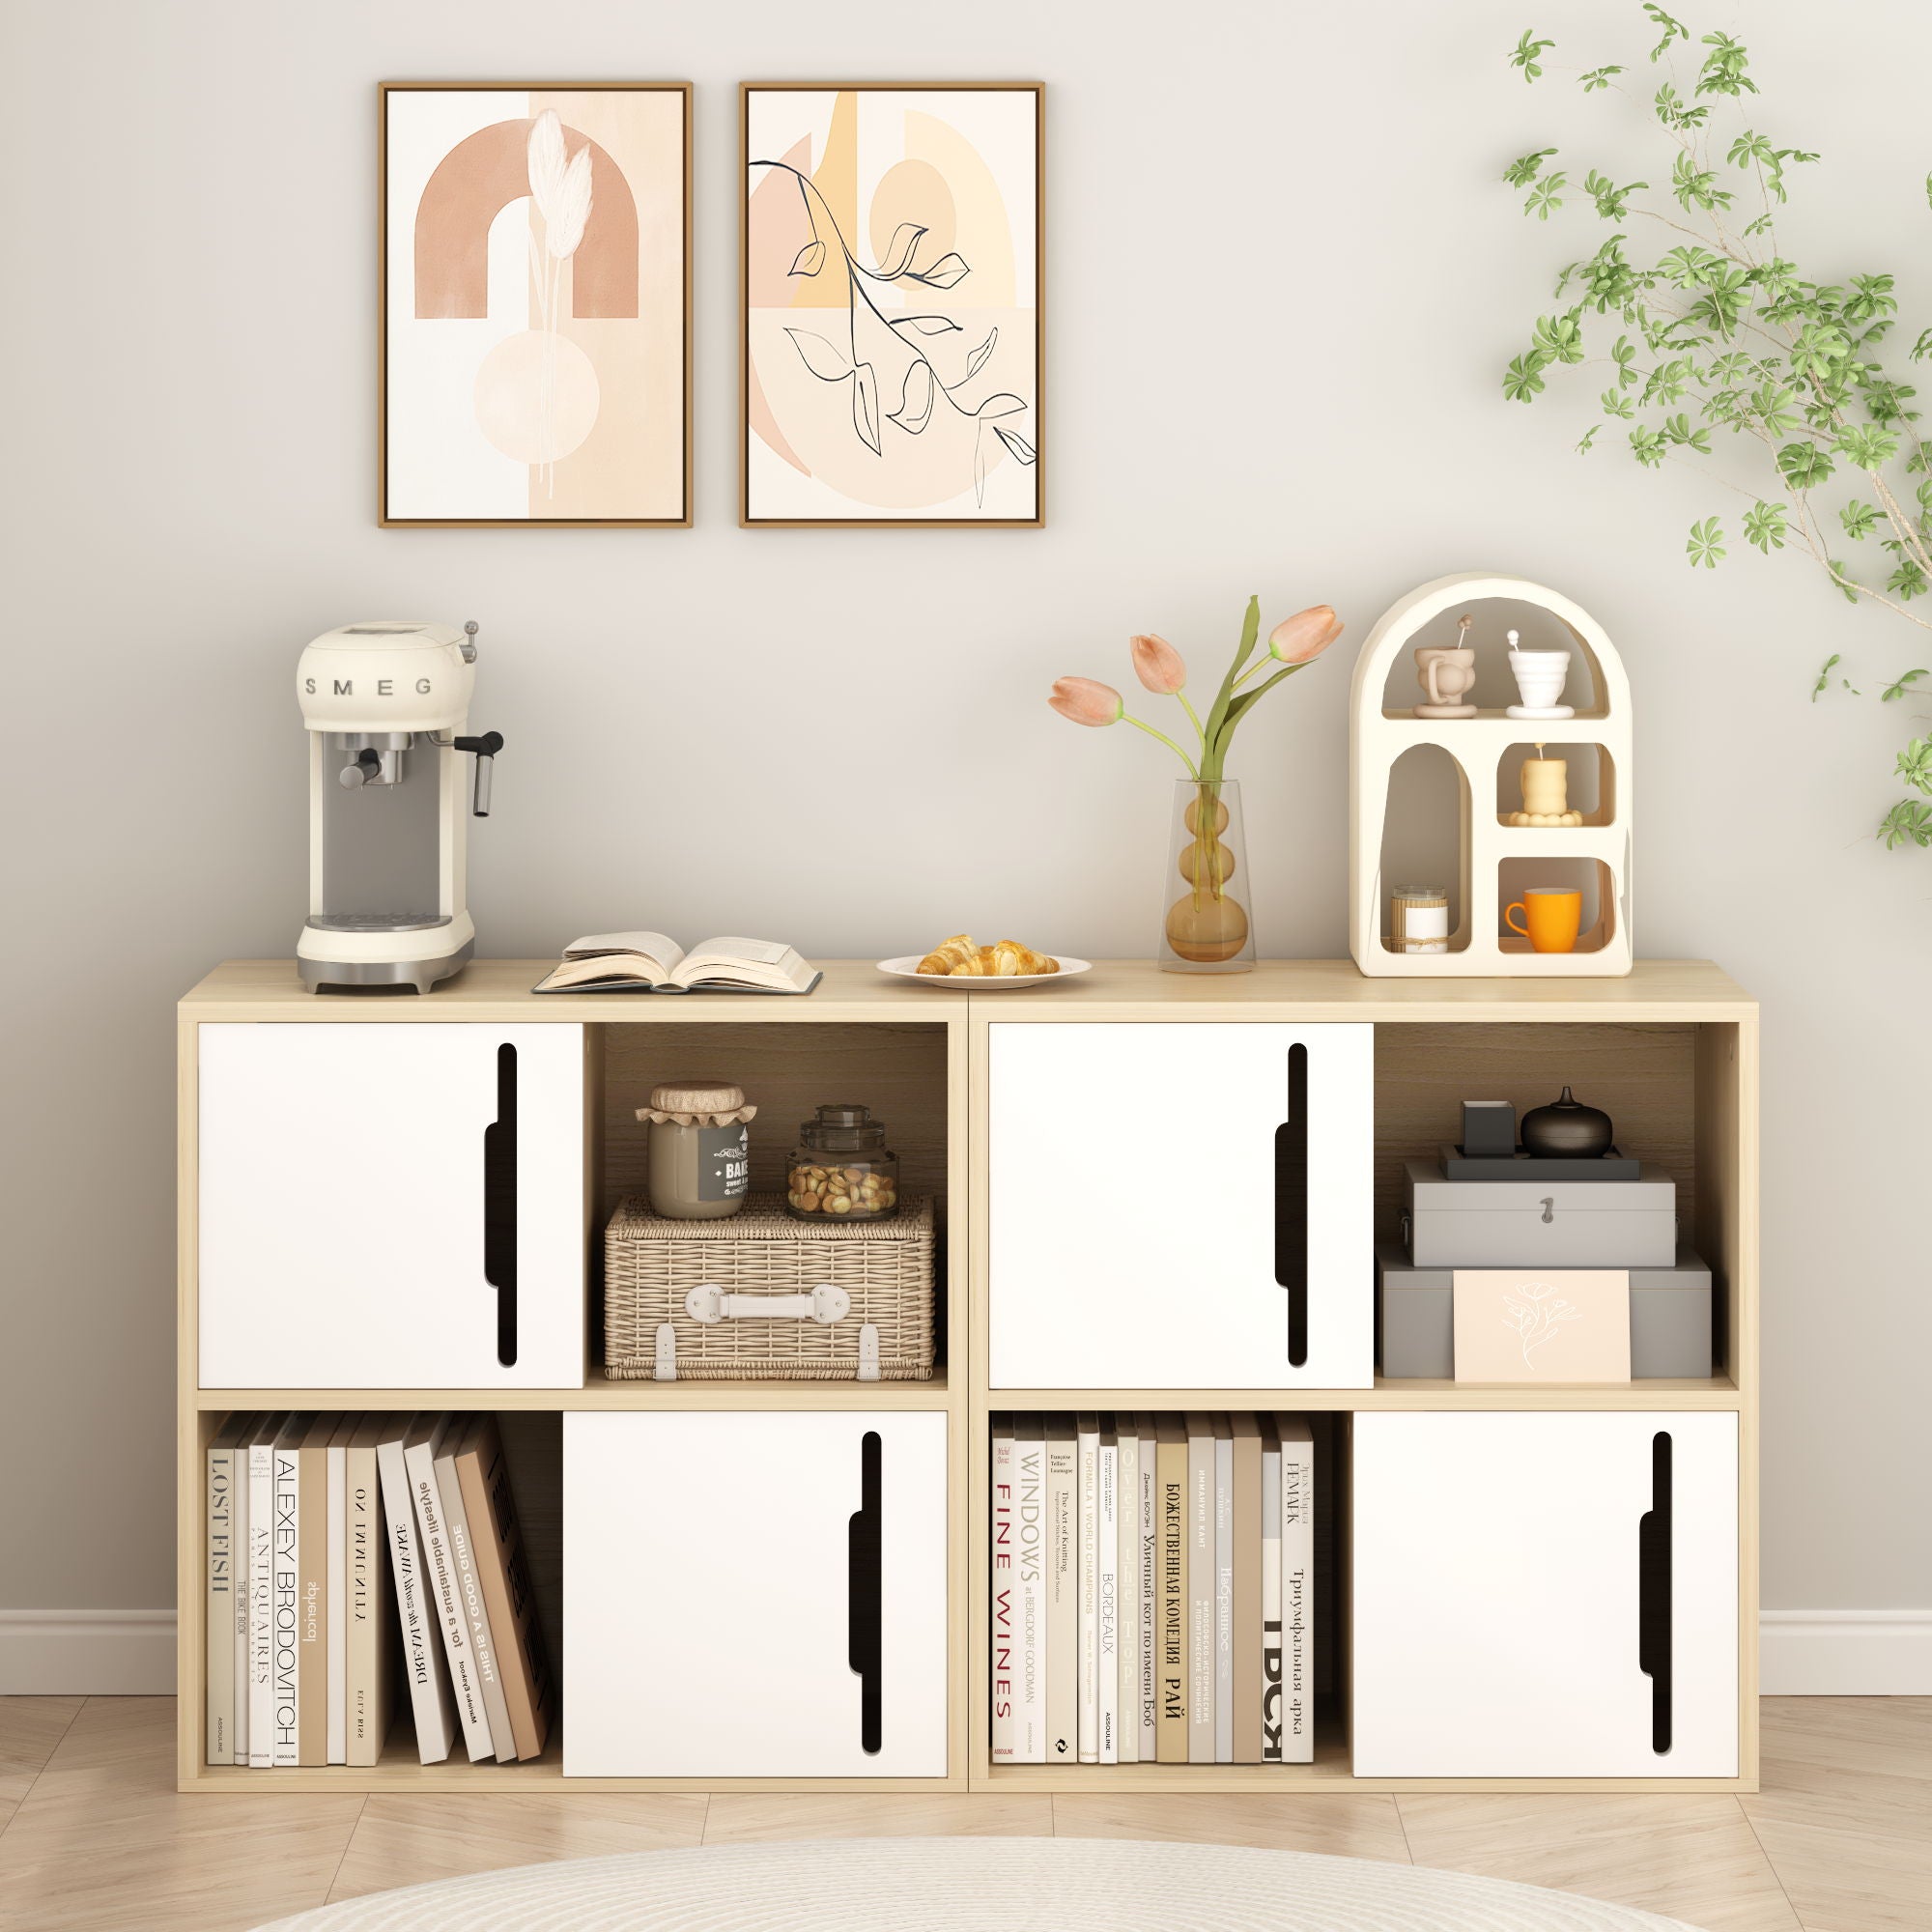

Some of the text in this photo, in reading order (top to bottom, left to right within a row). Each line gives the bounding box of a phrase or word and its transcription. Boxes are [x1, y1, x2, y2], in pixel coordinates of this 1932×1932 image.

[304, 677, 432, 696] SMEG
[1085, 1452, 1094, 1501] FORMULA
[1287, 1463, 1299, 1525] РЕМАРК
[212, 1459, 229, 1592] LOST FISH
[1020, 1452, 1039, 1582] WINDOWS
[1062, 1525, 1069, 1536] of
[1085, 1513, 1094, 1550] WORLD
[1061, 1537, 1069, 1573] Knitting
[1085, 1553, 1094, 1615] CHAMPIONS
[1164, 1484, 1180, 1664] БОЖЕСТВЕННАЯ КОМЕДИЯ
[237, 1580, 246, 1635] THE BIKE BOOK
[255, 1528, 270, 1684] ANTIQUAIRES
[277, 1459, 296, 1745] ALEXEY BRODOVITCH
[996, 1484, 1010, 1719] FINE WINES
[1025, 1597, 1035, 1648] BERGDORF
[1102, 1574, 1114, 1655] BORDEAUX
[1143, 1534, 1155, 1727] Уличный кот по имени Боб
[1025, 1650, 1035, 1703] GOODMAN
[1290, 1569, 1305, 1735] Триумфальная арка
[1165, 1678, 1185, 1719] РАЙ
